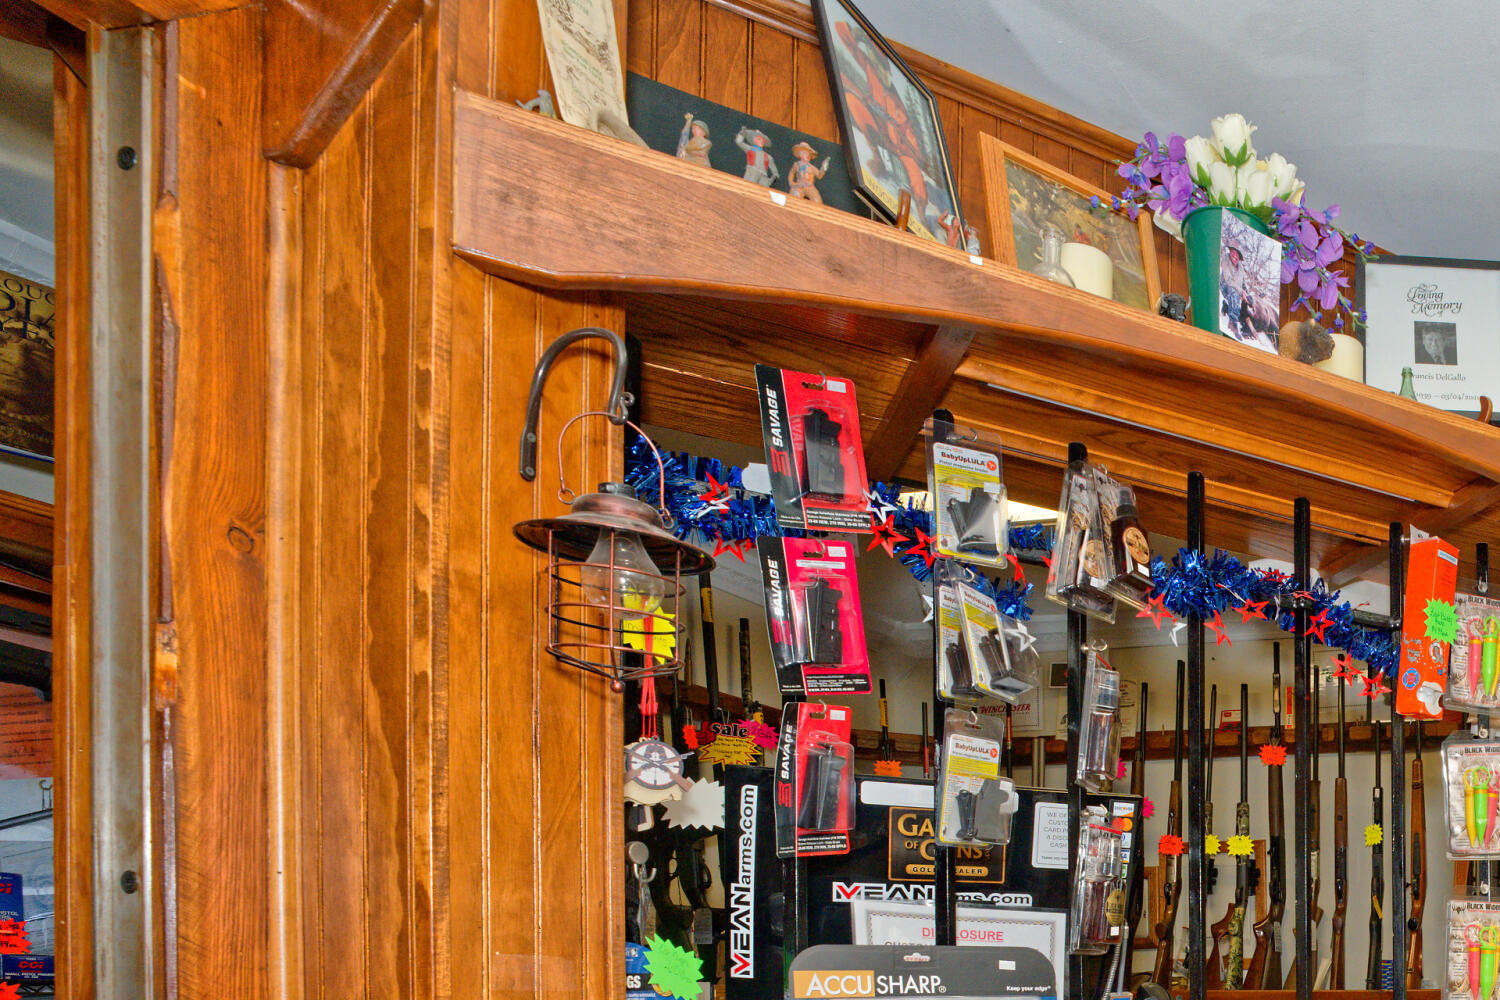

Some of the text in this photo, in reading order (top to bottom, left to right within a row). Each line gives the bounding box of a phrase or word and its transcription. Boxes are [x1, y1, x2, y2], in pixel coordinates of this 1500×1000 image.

[766, 389, 783, 447] SAVAGE
[711, 723, 748, 738] sale
[781, 724, 793, 780] SAVAGE
[904, 841, 919, 850] OF
